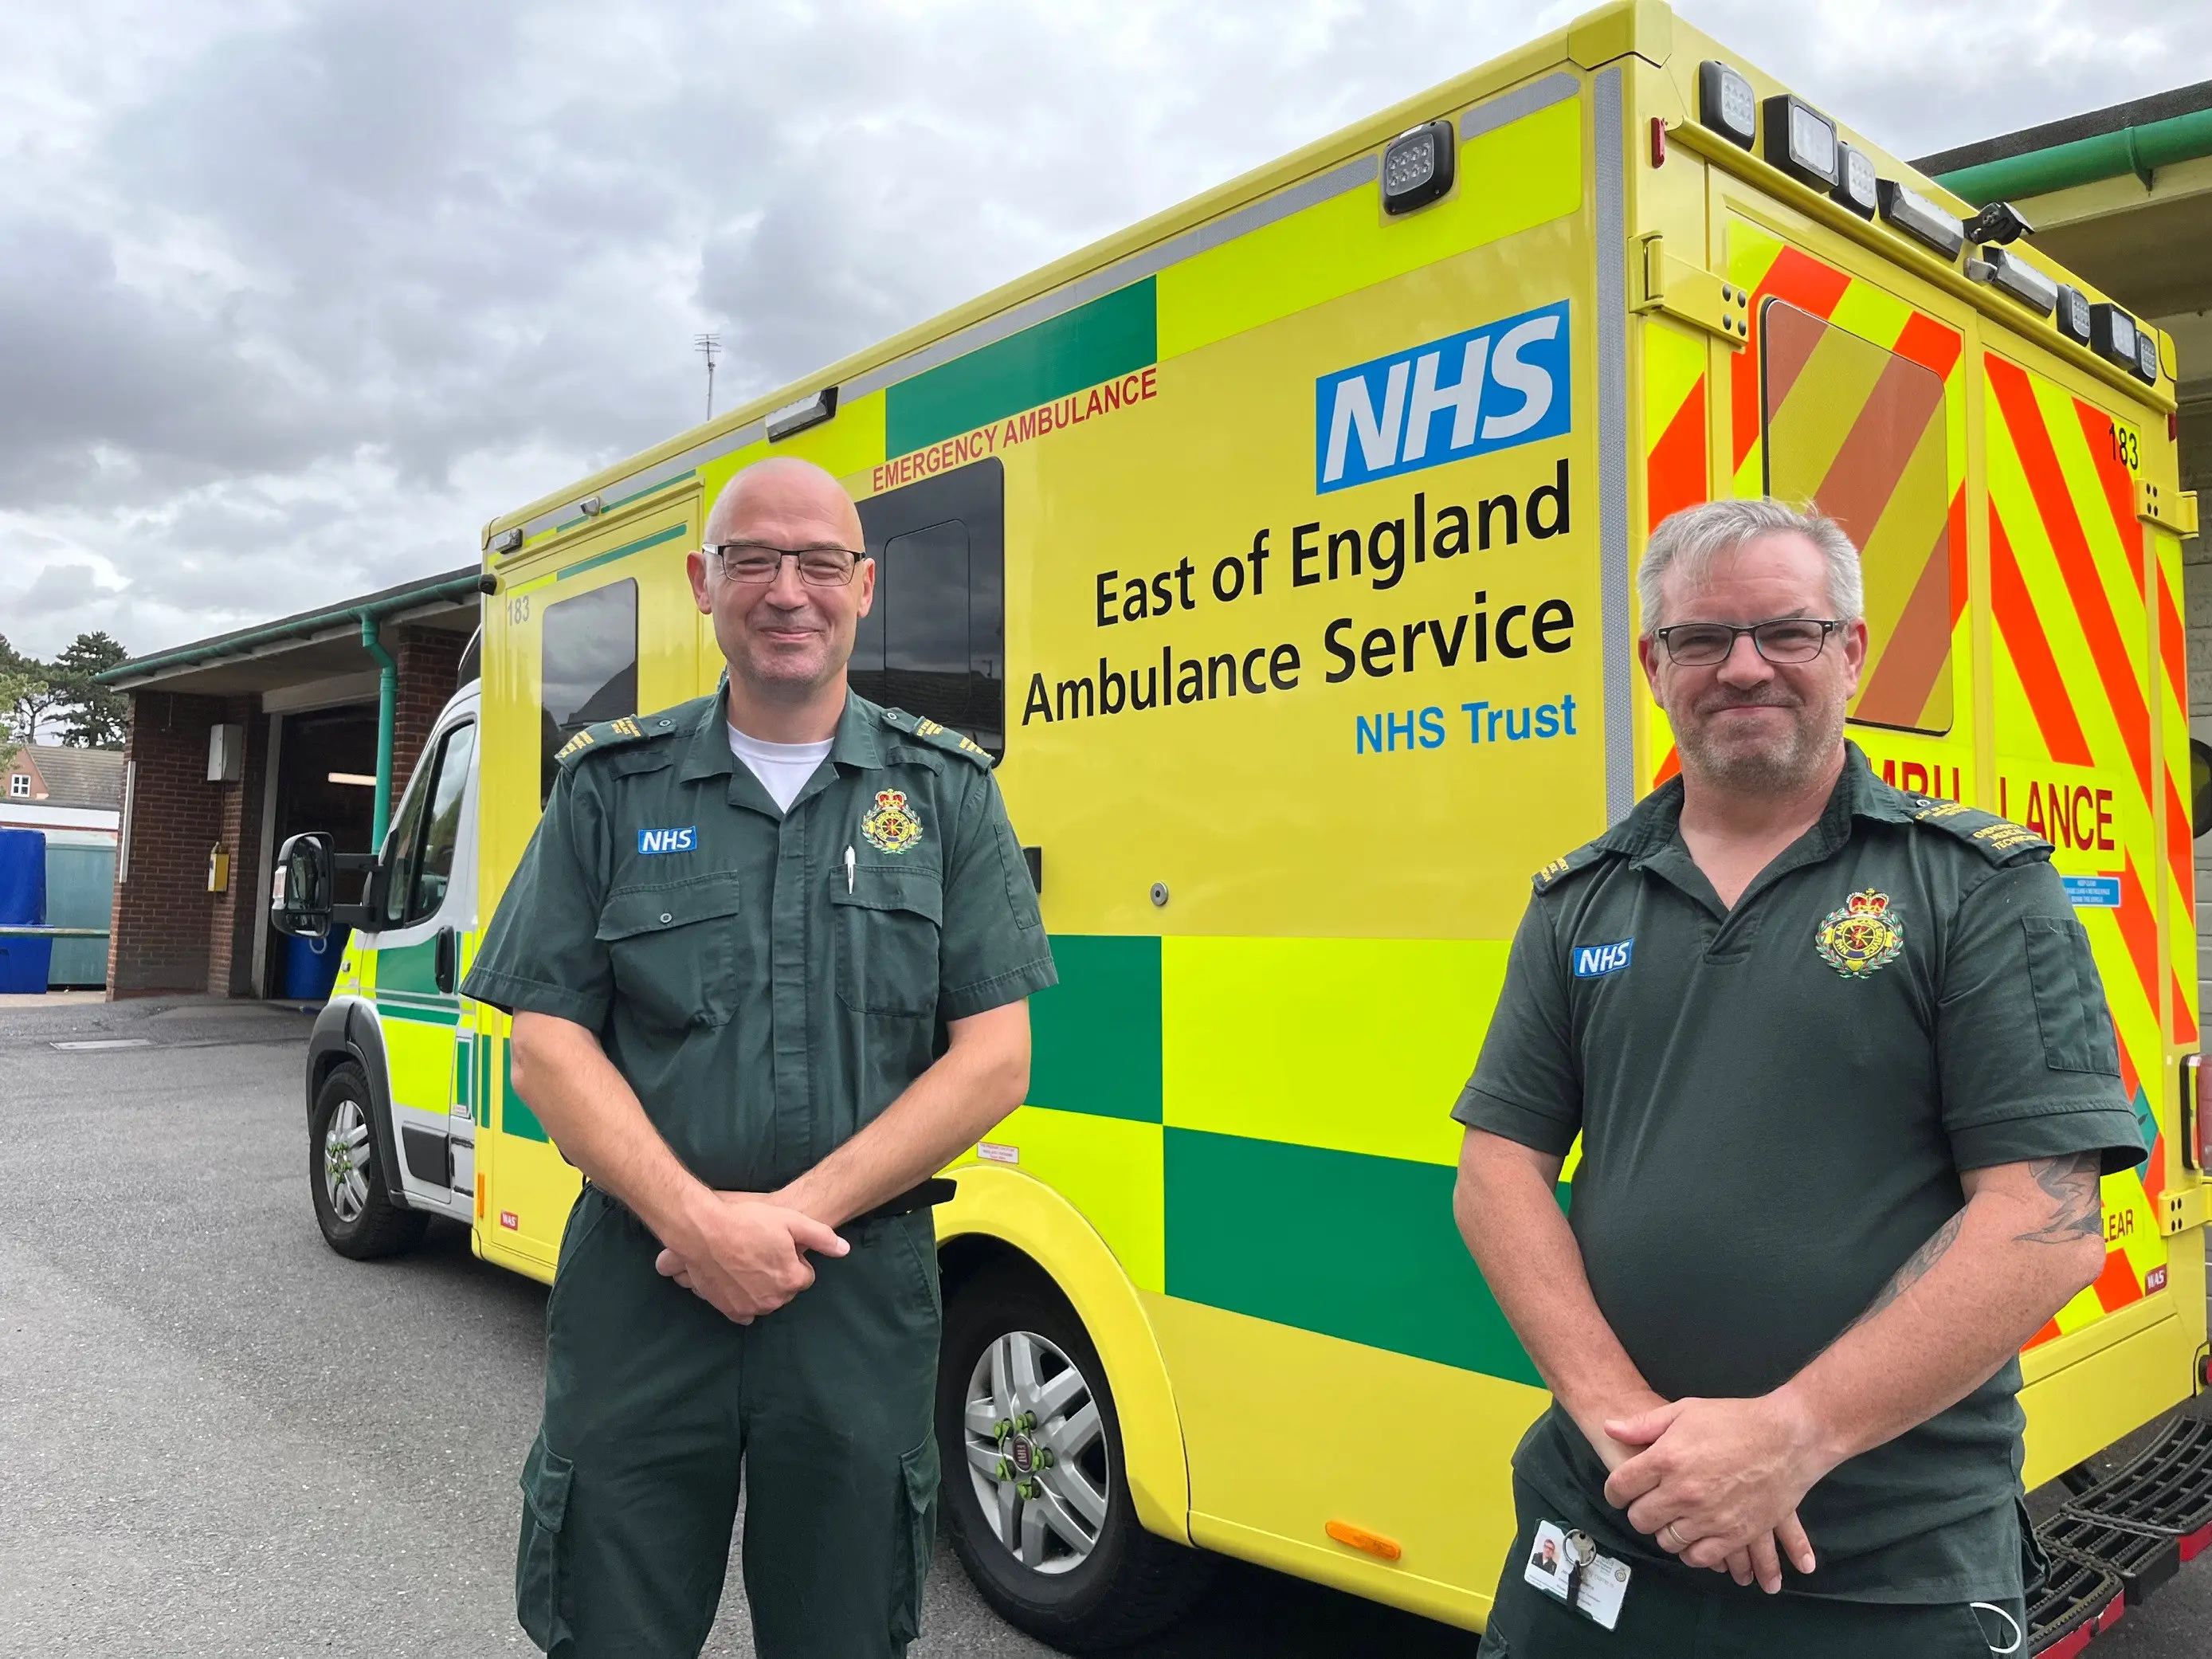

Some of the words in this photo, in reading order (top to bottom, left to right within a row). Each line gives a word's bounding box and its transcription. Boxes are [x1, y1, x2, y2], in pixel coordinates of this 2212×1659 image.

[1323, 315, 1560, 484] NHS
[873, 425, 998, 492] EMERGENCY
[1002, 367, 1158, 449] AMBULANCE
[2108, 422, 2139, 470] 183
[1096, 555, 1195, 628] East
[1211, 528, 1270, 603] of
[1292, 457, 1571, 590] England
[508, 595, 529, 626] 183
[1021, 645, 1301, 727] Ambulance
[1324, 590, 1575, 684] Service
[1356, 705, 1446, 755] NHS
[1461, 694, 1577, 744] Trust
[642, 830, 692, 852] NHS
[1579, 941, 1630, 974] NHS
[2101, 1208, 2134, 1243] LEAR
